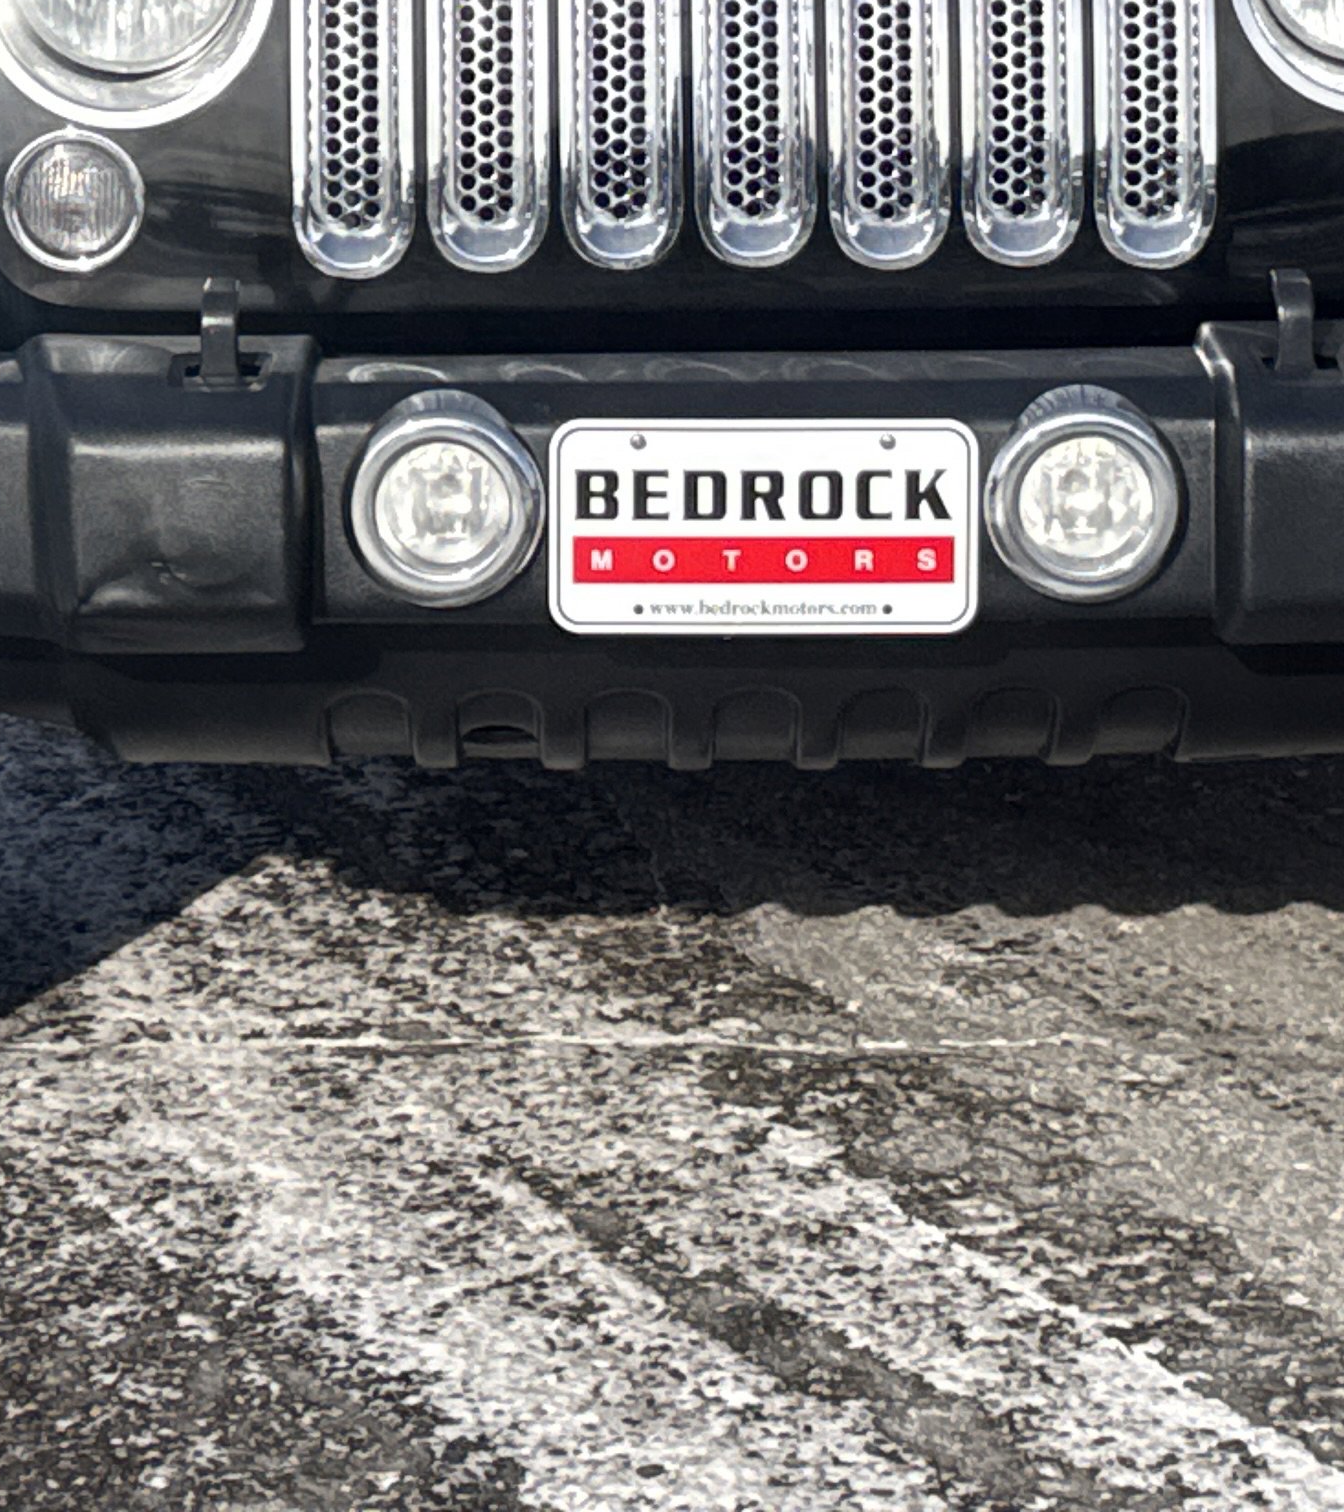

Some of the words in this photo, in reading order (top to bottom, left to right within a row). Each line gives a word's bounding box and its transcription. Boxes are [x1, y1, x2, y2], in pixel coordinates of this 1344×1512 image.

[574, 469, 953, 521] BEDROCK
[590, 549, 938, 572] MOTORS
[649, 598, 878, 616] www.bedrockmotors.com
